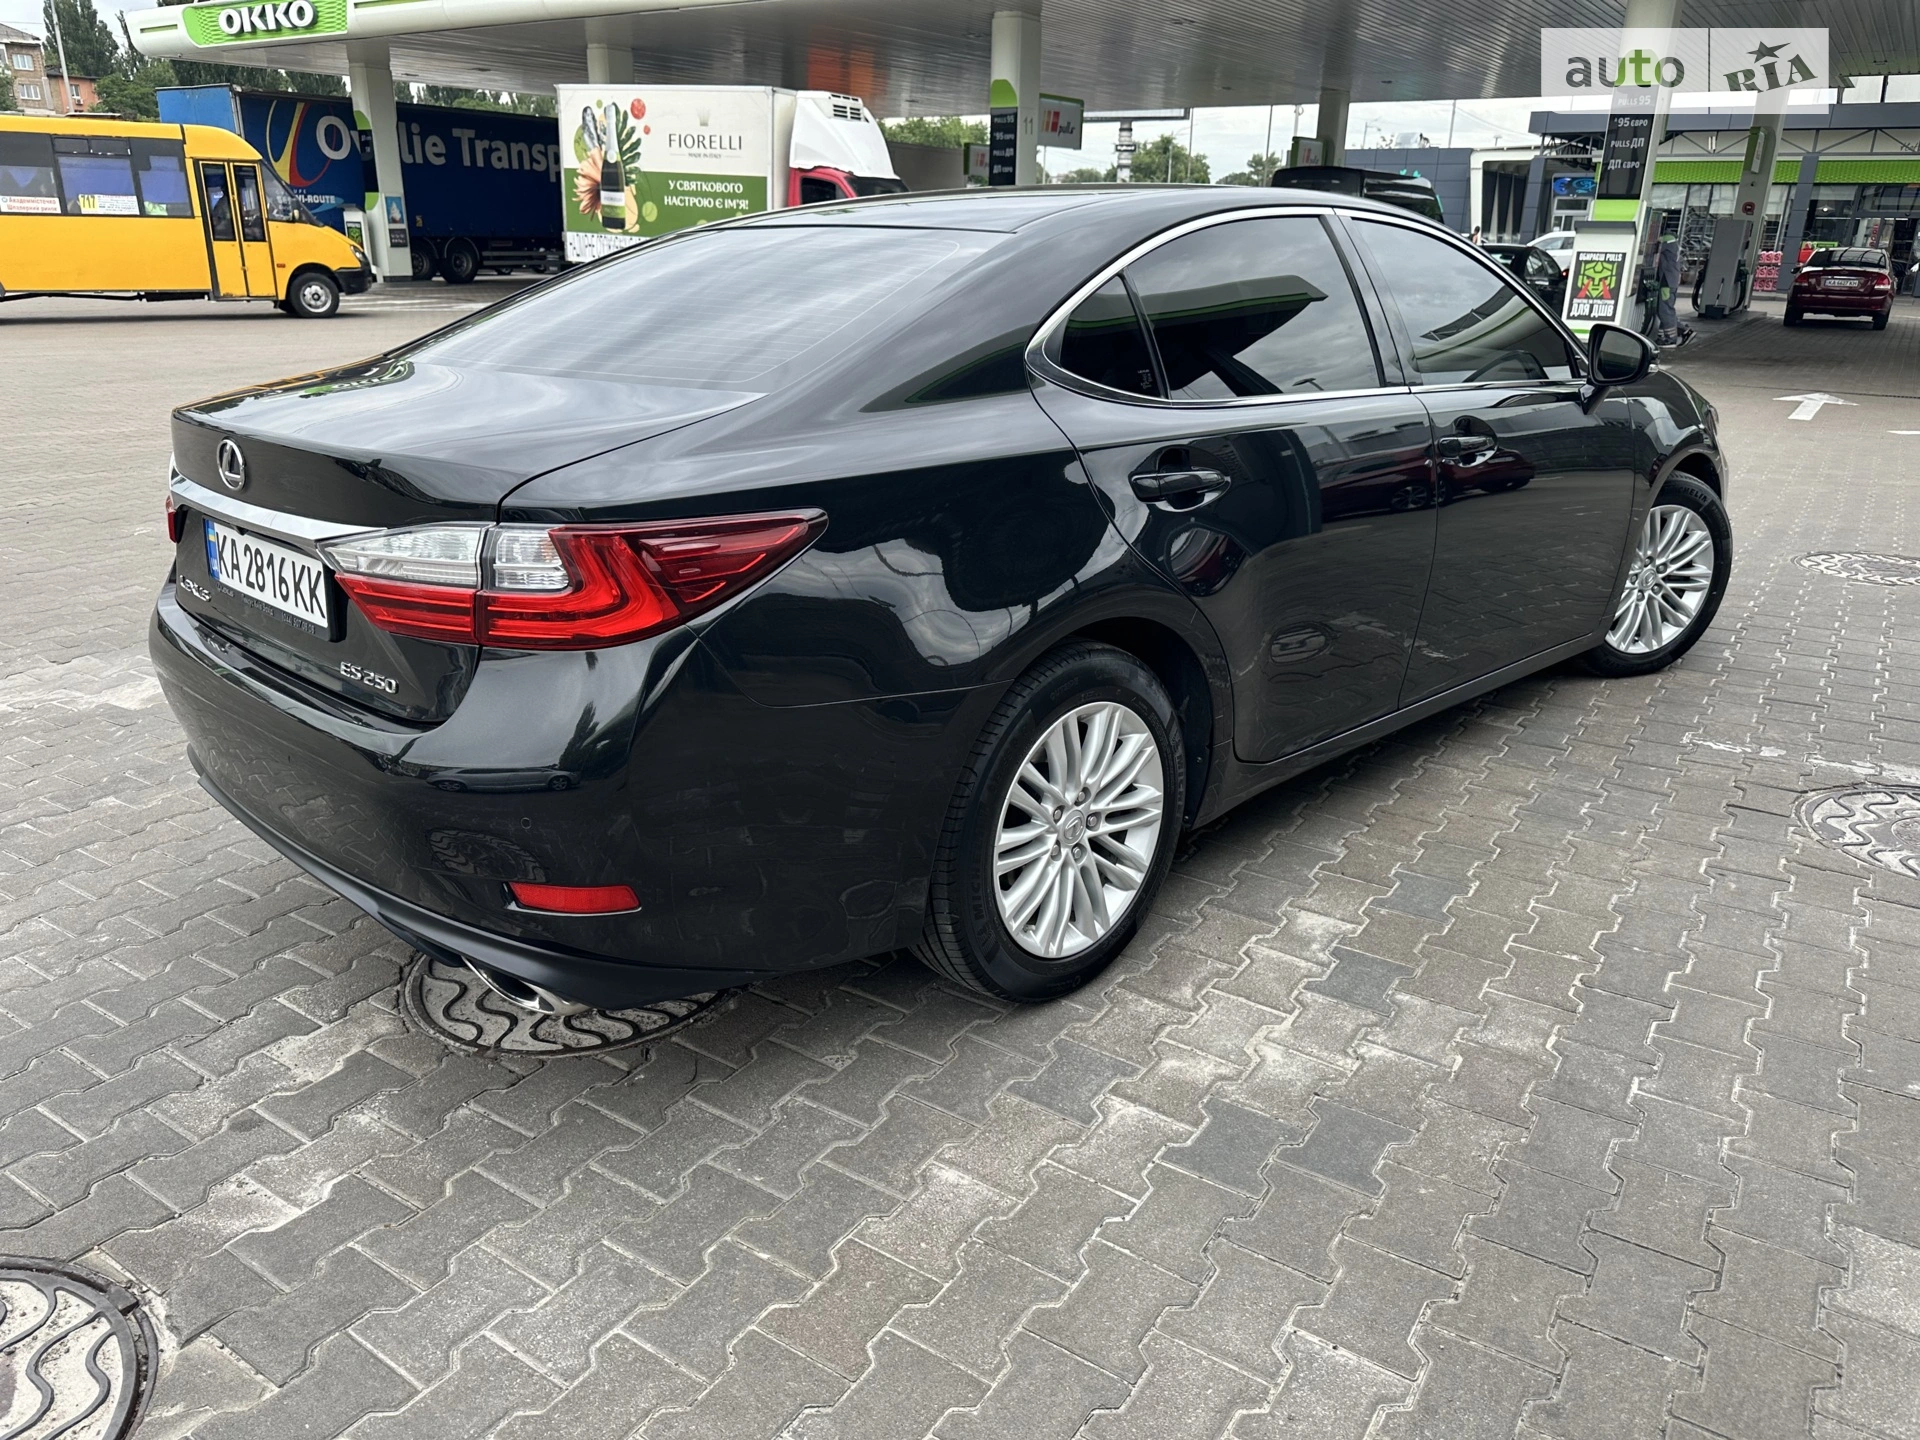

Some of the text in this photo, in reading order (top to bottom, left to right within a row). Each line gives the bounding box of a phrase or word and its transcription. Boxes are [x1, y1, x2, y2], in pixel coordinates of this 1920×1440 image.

[218, 0, 314, 35] OKKO
[1618, 95, 1651, 106] PULLS 95
[1006, 115, 1015, 123] 95
[668, 133, 742, 151] FIORELLI
[1610, 137, 1645, 149] PULLS ДП
[1607, 159, 1621, 170] ДП
[668, 180, 743, 194] У СВЯТКОВОГО
[81, 195, 96, 209] 717
[664, 195, 714, 208] НАСТРОЮ
[715, 198, 723, 208] Є
[1570, 303, 1614, 318] ДЛЯ ДШВ
[215, 531, 326, 620] KA 2816 KK
[179, 575, 212, 603] LEXUS
[340, 661, 400, 695] ES 250
